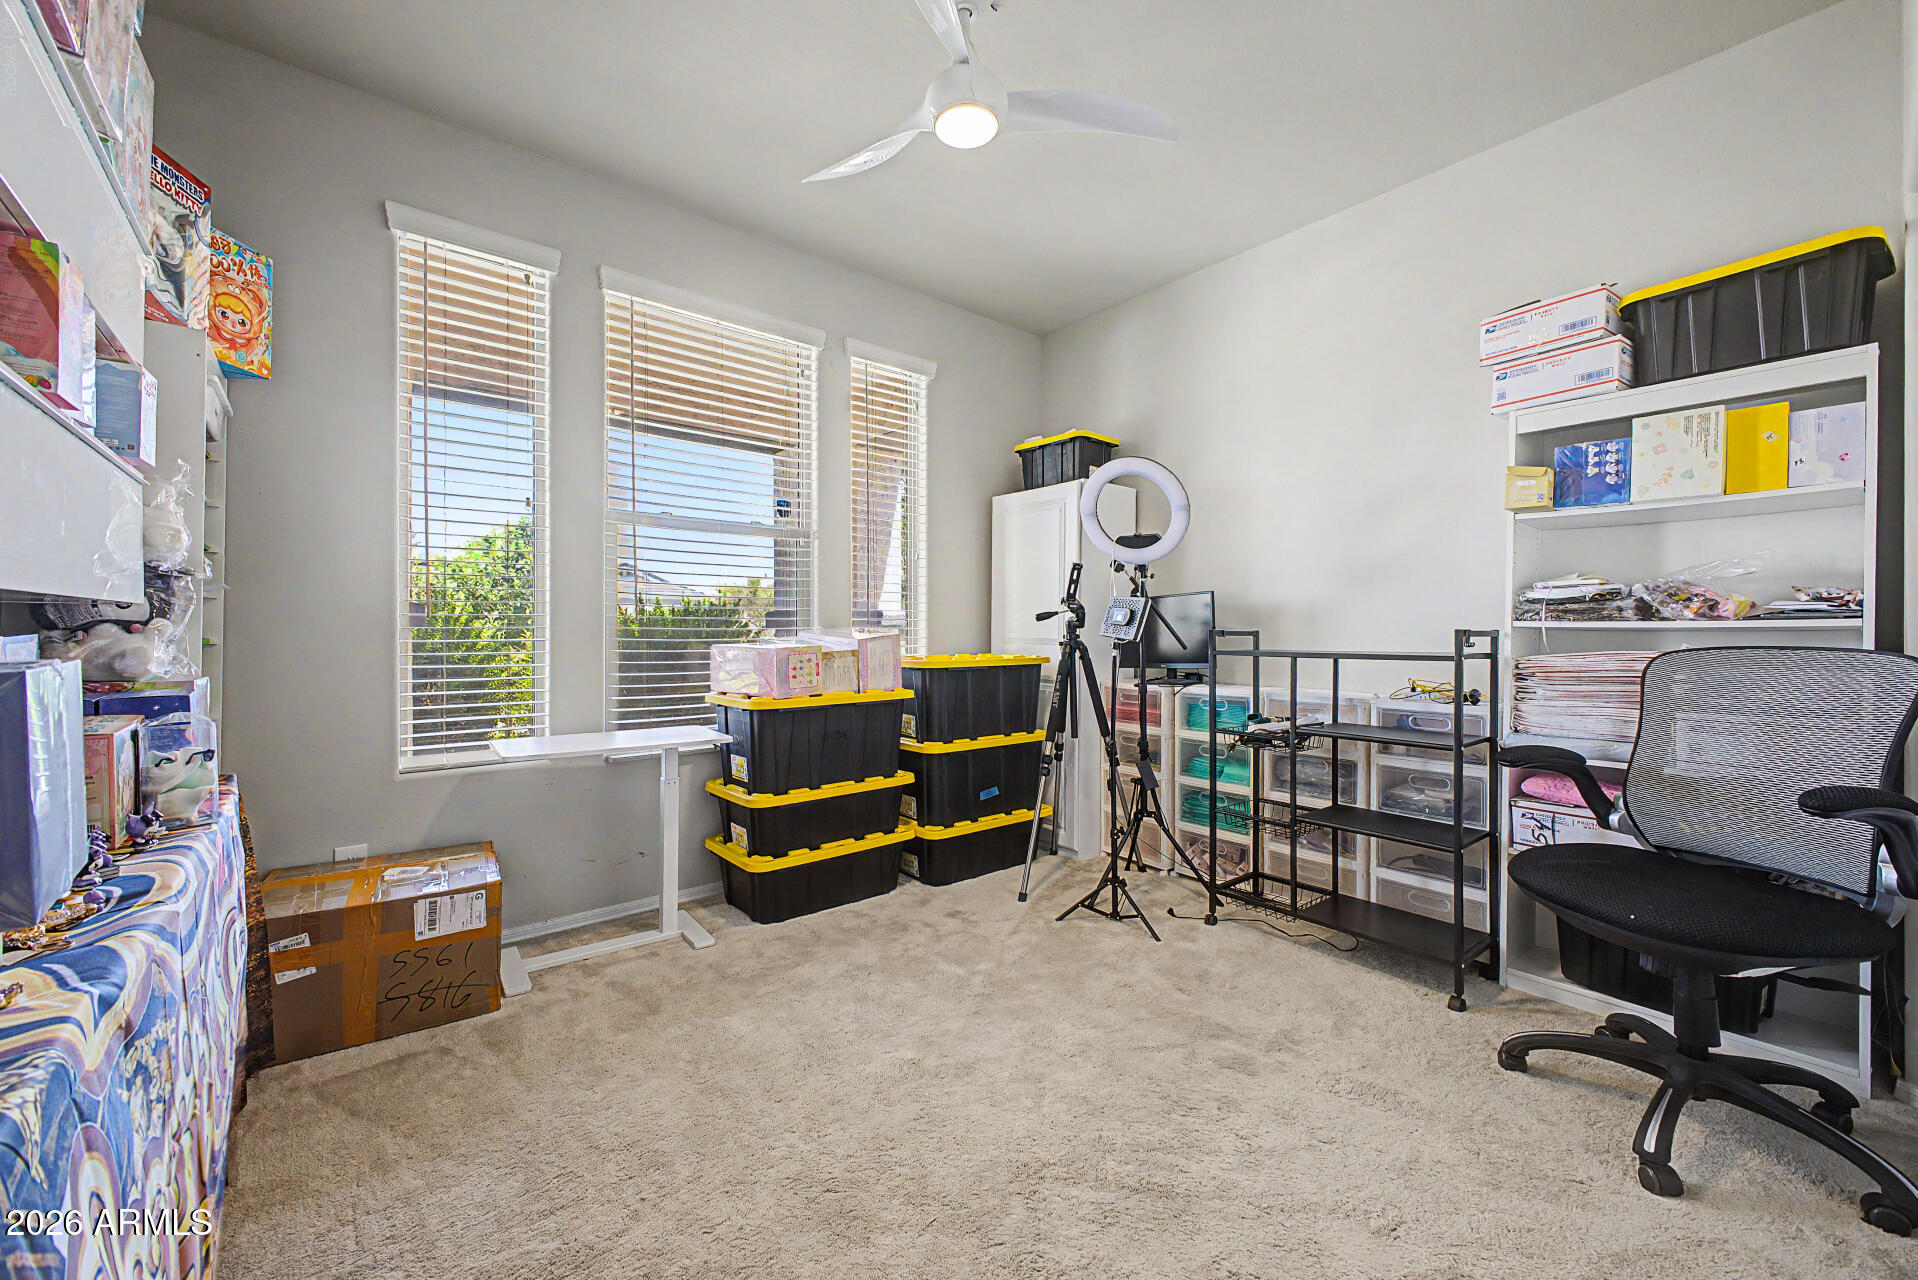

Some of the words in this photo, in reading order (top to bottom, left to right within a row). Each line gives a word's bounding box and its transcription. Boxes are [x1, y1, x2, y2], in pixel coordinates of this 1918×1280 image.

[151, 169, 172, 192] ELLO
[174, 187, 202, 214] KITTY
[160, 161, 203, 202] MONSTERS
[475, 892, 484, 900] G
